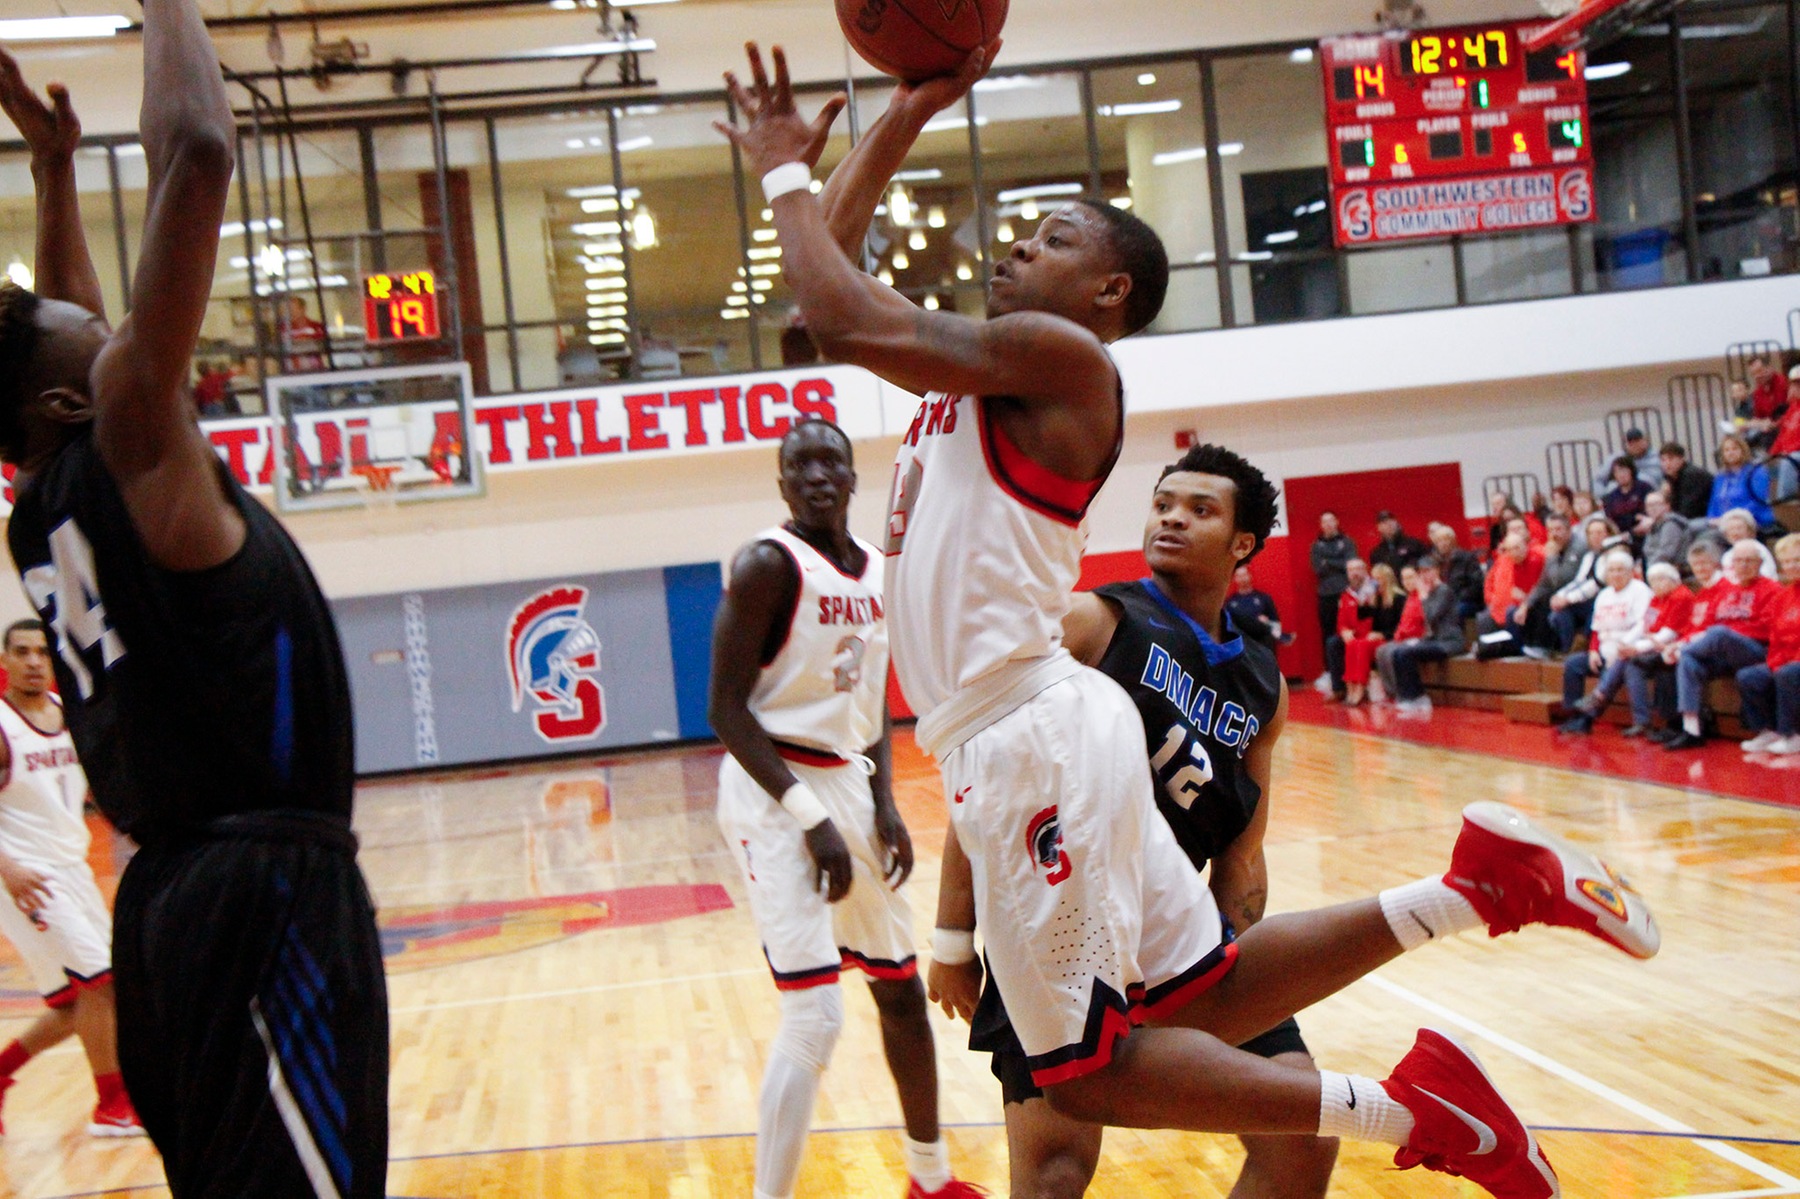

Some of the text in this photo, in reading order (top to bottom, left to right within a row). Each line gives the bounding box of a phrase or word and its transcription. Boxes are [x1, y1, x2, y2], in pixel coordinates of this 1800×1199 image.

[1411, 30, 1508, 74] 12:47
[1354, 63, 1385, 99] 14
[1478, 79, 1489, 109] 1
[1561, 119, 1583, 147] 4
[1363, 138, 1375, 167] 1
[1374, 175, 1553, 211] SOUTHWESTERN
[1374, 199, 1555, 236] COMMUNITY COLLEGE
[390, 299, 426, 339] 19
[1140, 642, 1259, 759] DMACC
[1150, 723, 1214, 811] 12
